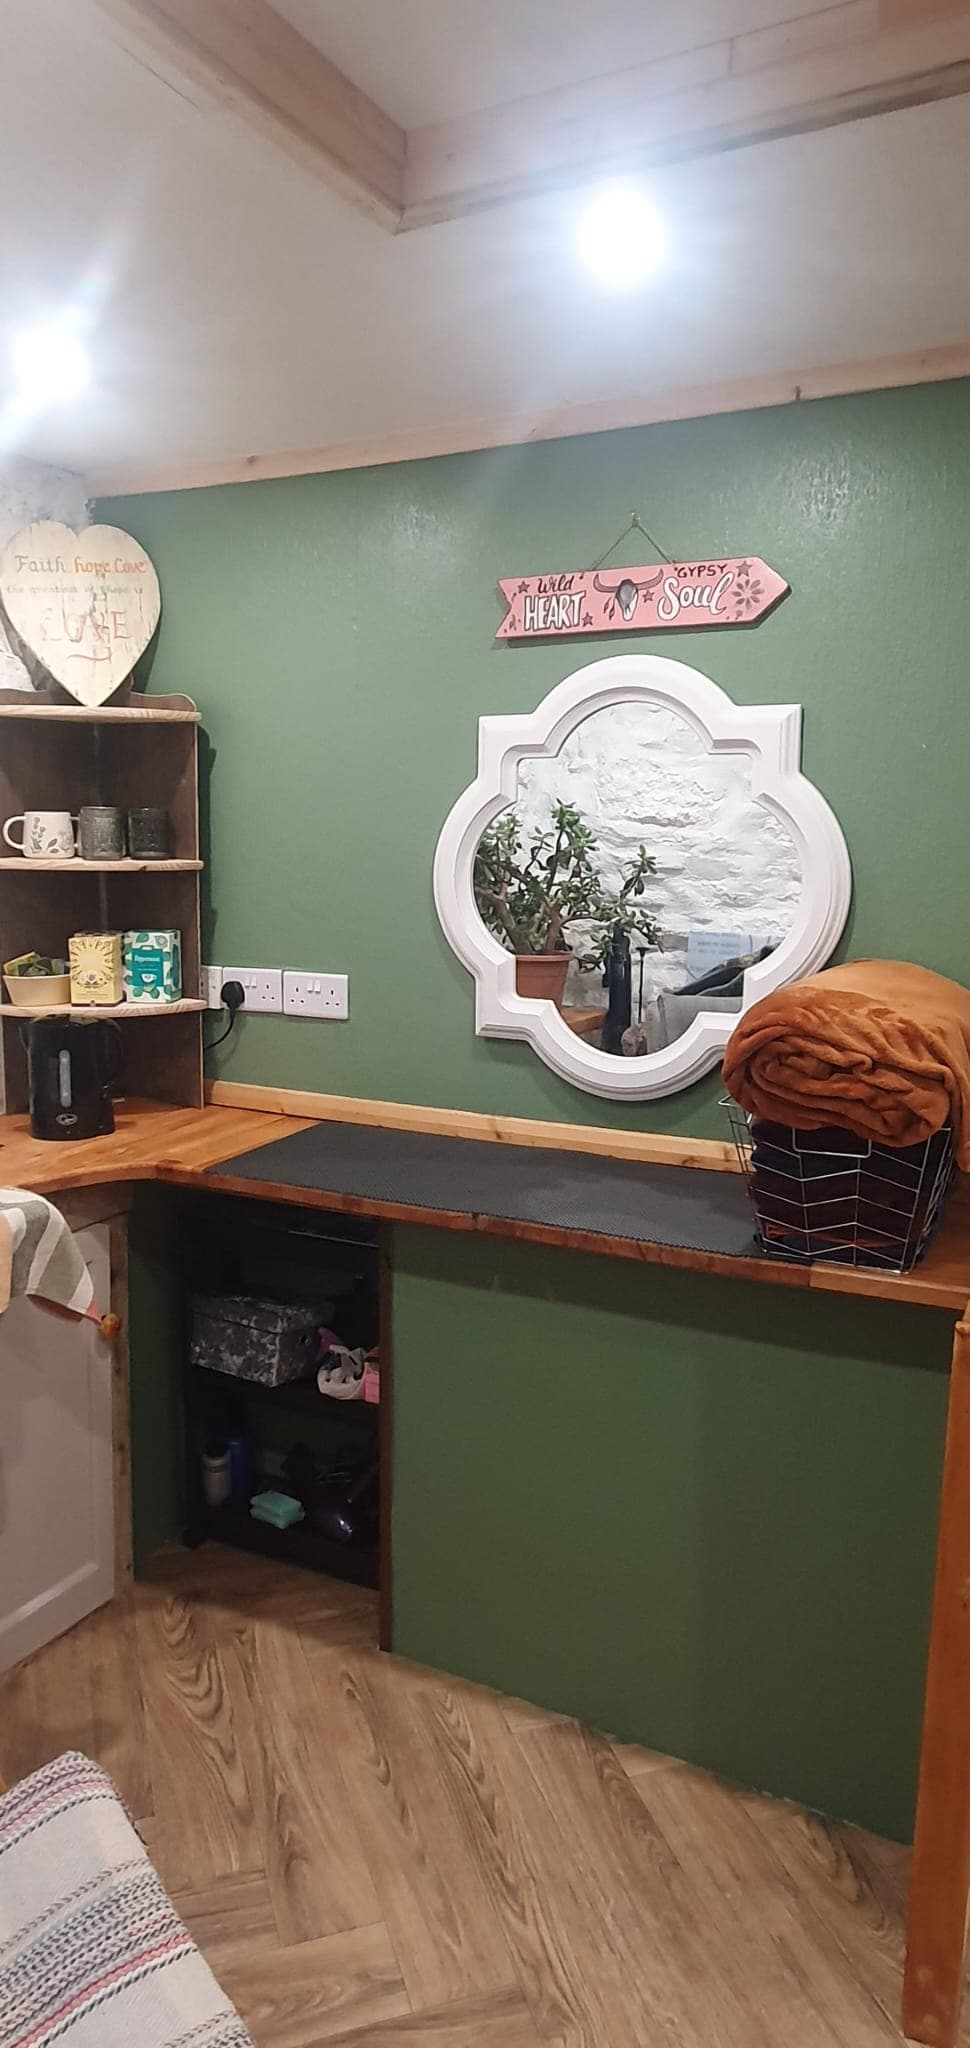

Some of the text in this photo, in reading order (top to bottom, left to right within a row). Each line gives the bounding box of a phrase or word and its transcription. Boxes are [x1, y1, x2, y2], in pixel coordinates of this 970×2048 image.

[14, 555, 66, 573] Faith
[73, 556, 111, 576] hope
[677, 563, 728, 578] GYPSY
[537, 575, 574, 594] Wild
[657, 572, 734, 620] Soul
[524, 591, 586, 632] HEART
